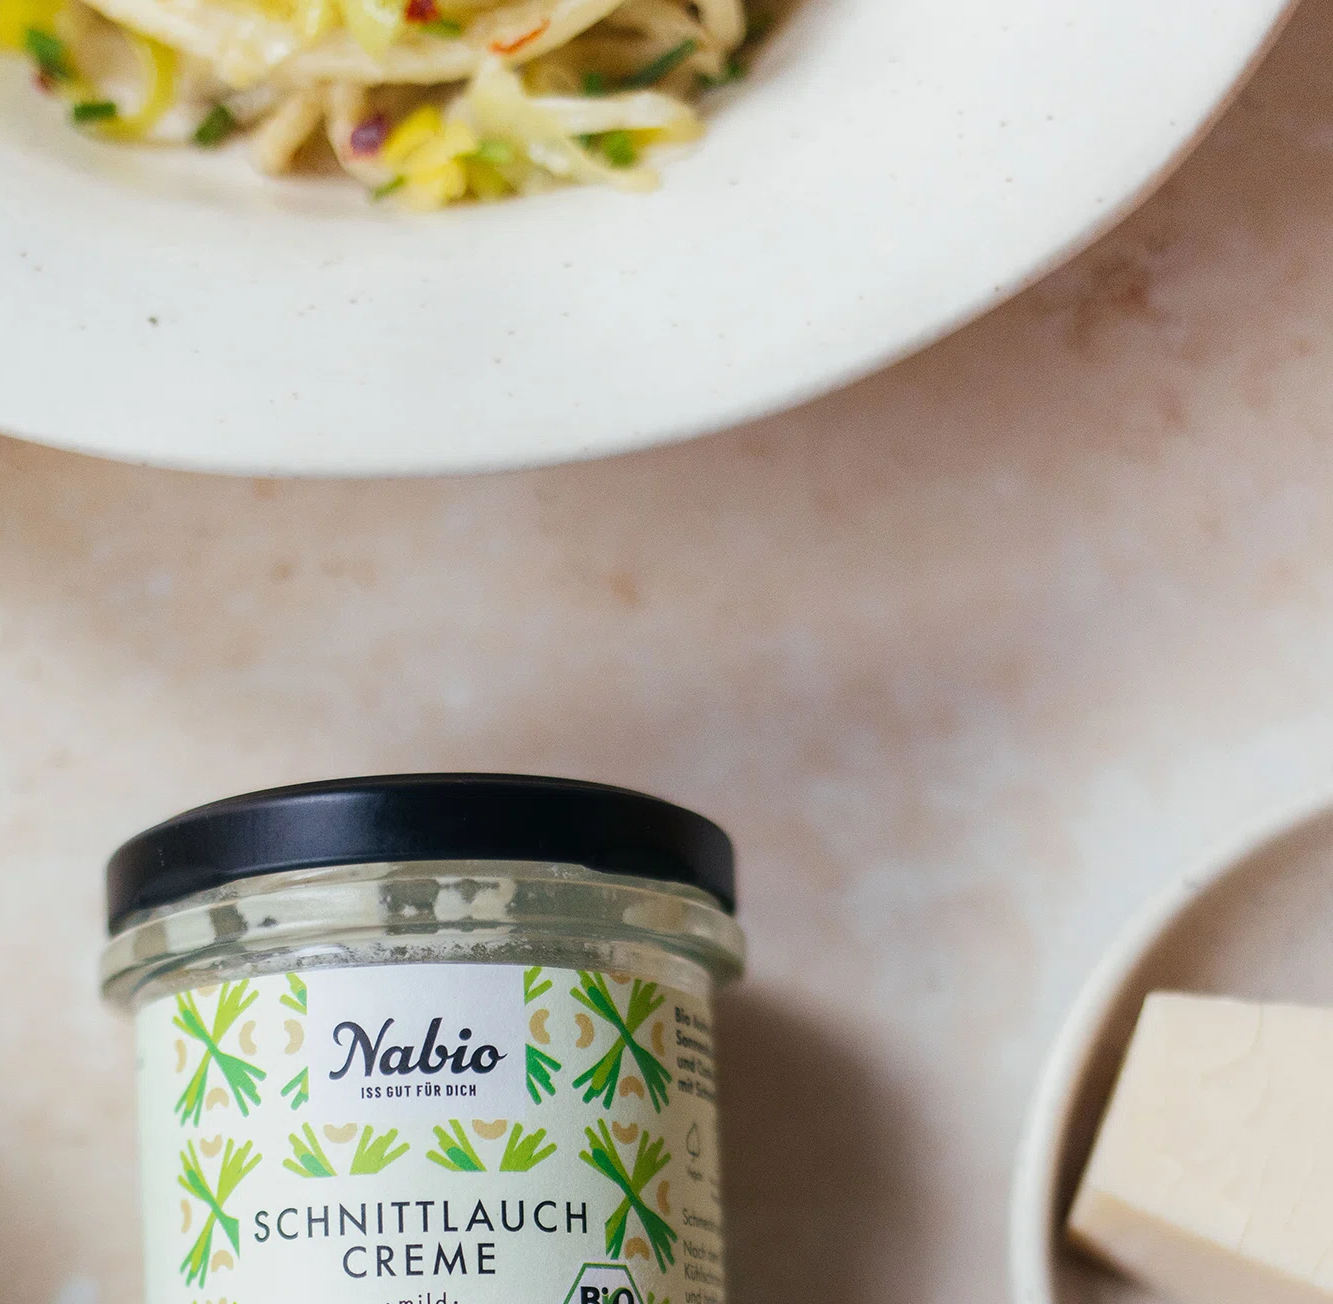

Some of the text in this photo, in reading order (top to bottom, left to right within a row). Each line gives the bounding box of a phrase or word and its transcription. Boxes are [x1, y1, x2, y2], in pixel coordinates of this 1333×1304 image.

[329, 1017, 508, 1080] Nabio
[361, 1082, 477, 1099] ISS GUT FÜR DICH
[254, 1199, 588, 1243] SCHNITTLAUCH
[342, 1242, 497, 1279] CREME
